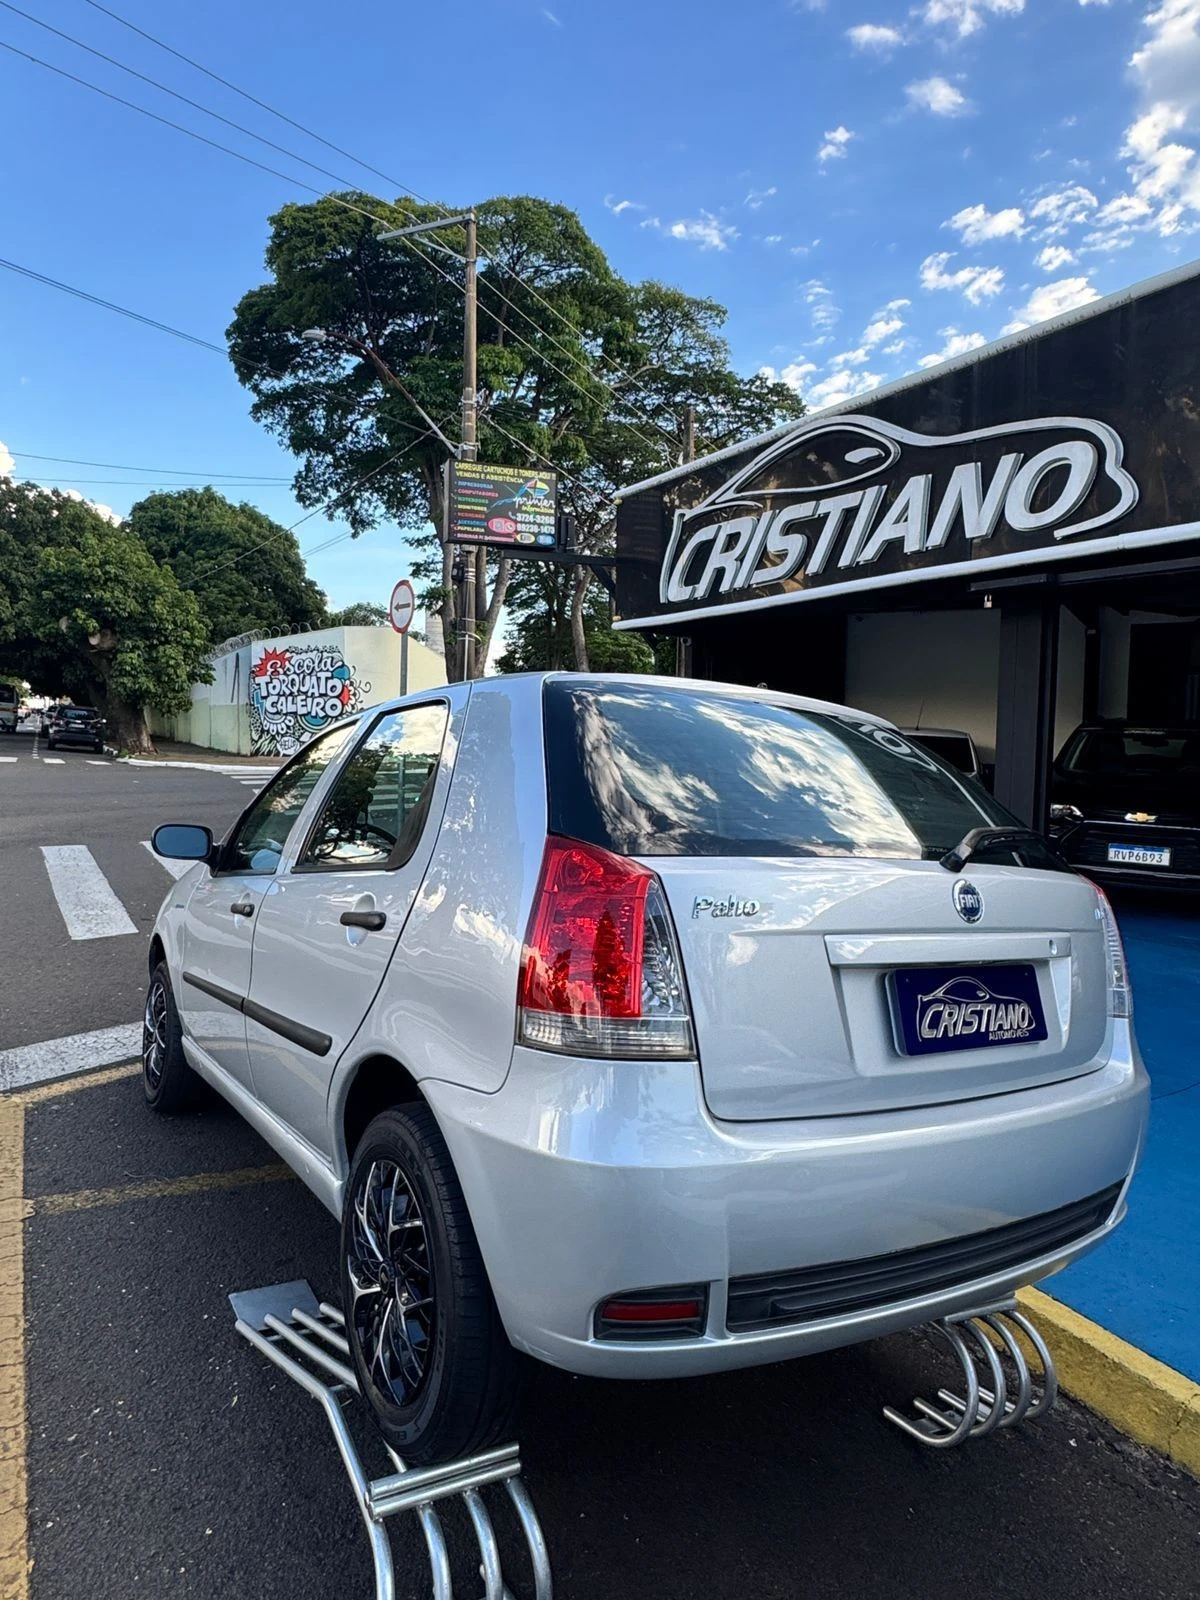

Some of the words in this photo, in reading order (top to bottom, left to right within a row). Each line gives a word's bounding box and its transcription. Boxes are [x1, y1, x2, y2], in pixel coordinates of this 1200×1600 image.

[456, 470, 480, 479] VENDAS
[483, 465, 513, 476] CARTUCHOS
[668, 441, 1099, 603] CRISTIANO
[267, 652, 343, 676] Escola
[266, 695, 343, 717] CALEIRO
[1113, 850, 1163, 863] RVP6B93
[692, 894, 760, 919] Palio
[959, 894, 980, 908] FIAT
[921, 1003, 1029, 1038] CRISTIANO
